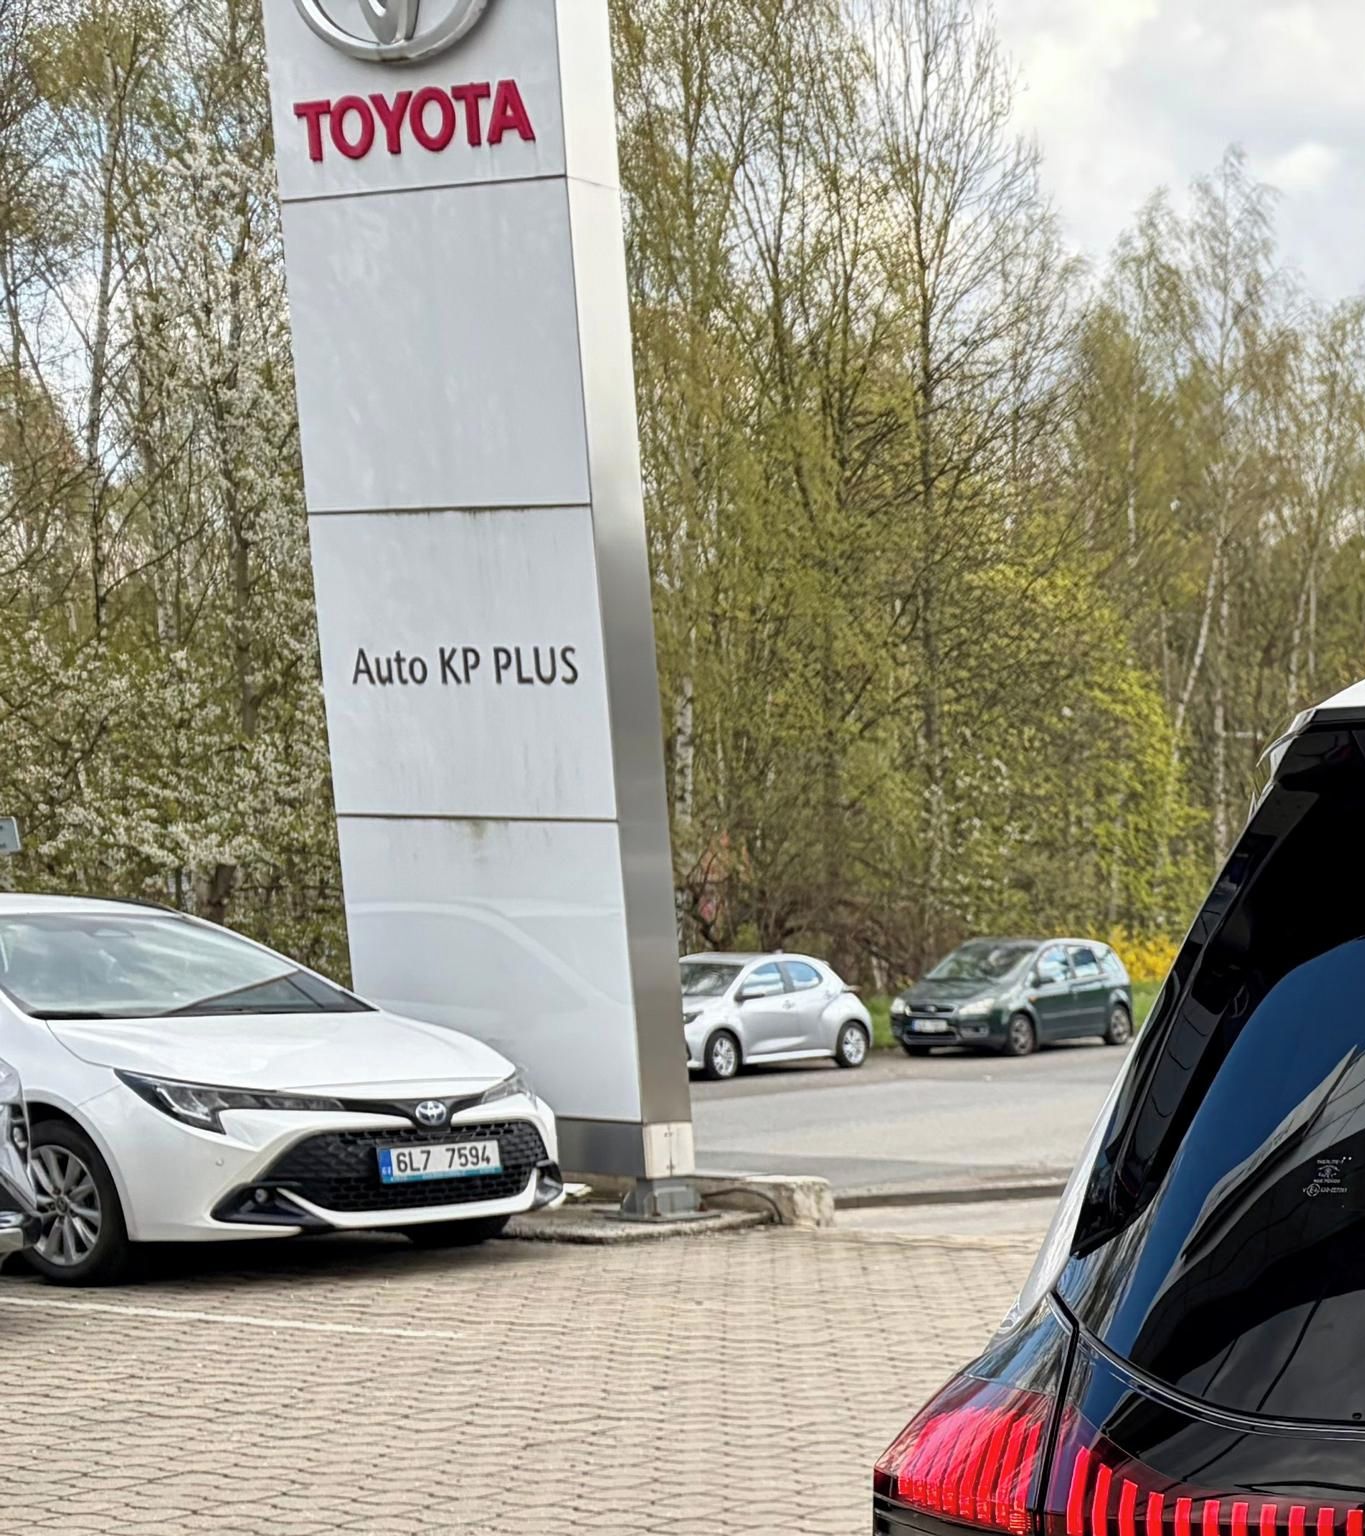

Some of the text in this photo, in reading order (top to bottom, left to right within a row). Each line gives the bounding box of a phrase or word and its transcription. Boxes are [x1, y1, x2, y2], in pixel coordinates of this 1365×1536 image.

[294, 79, 536, 162] TOYOTA
[353, 647, 579, 686] Auto KP PLUS
[396, 1144, 491, 1173] 6L7 7594
